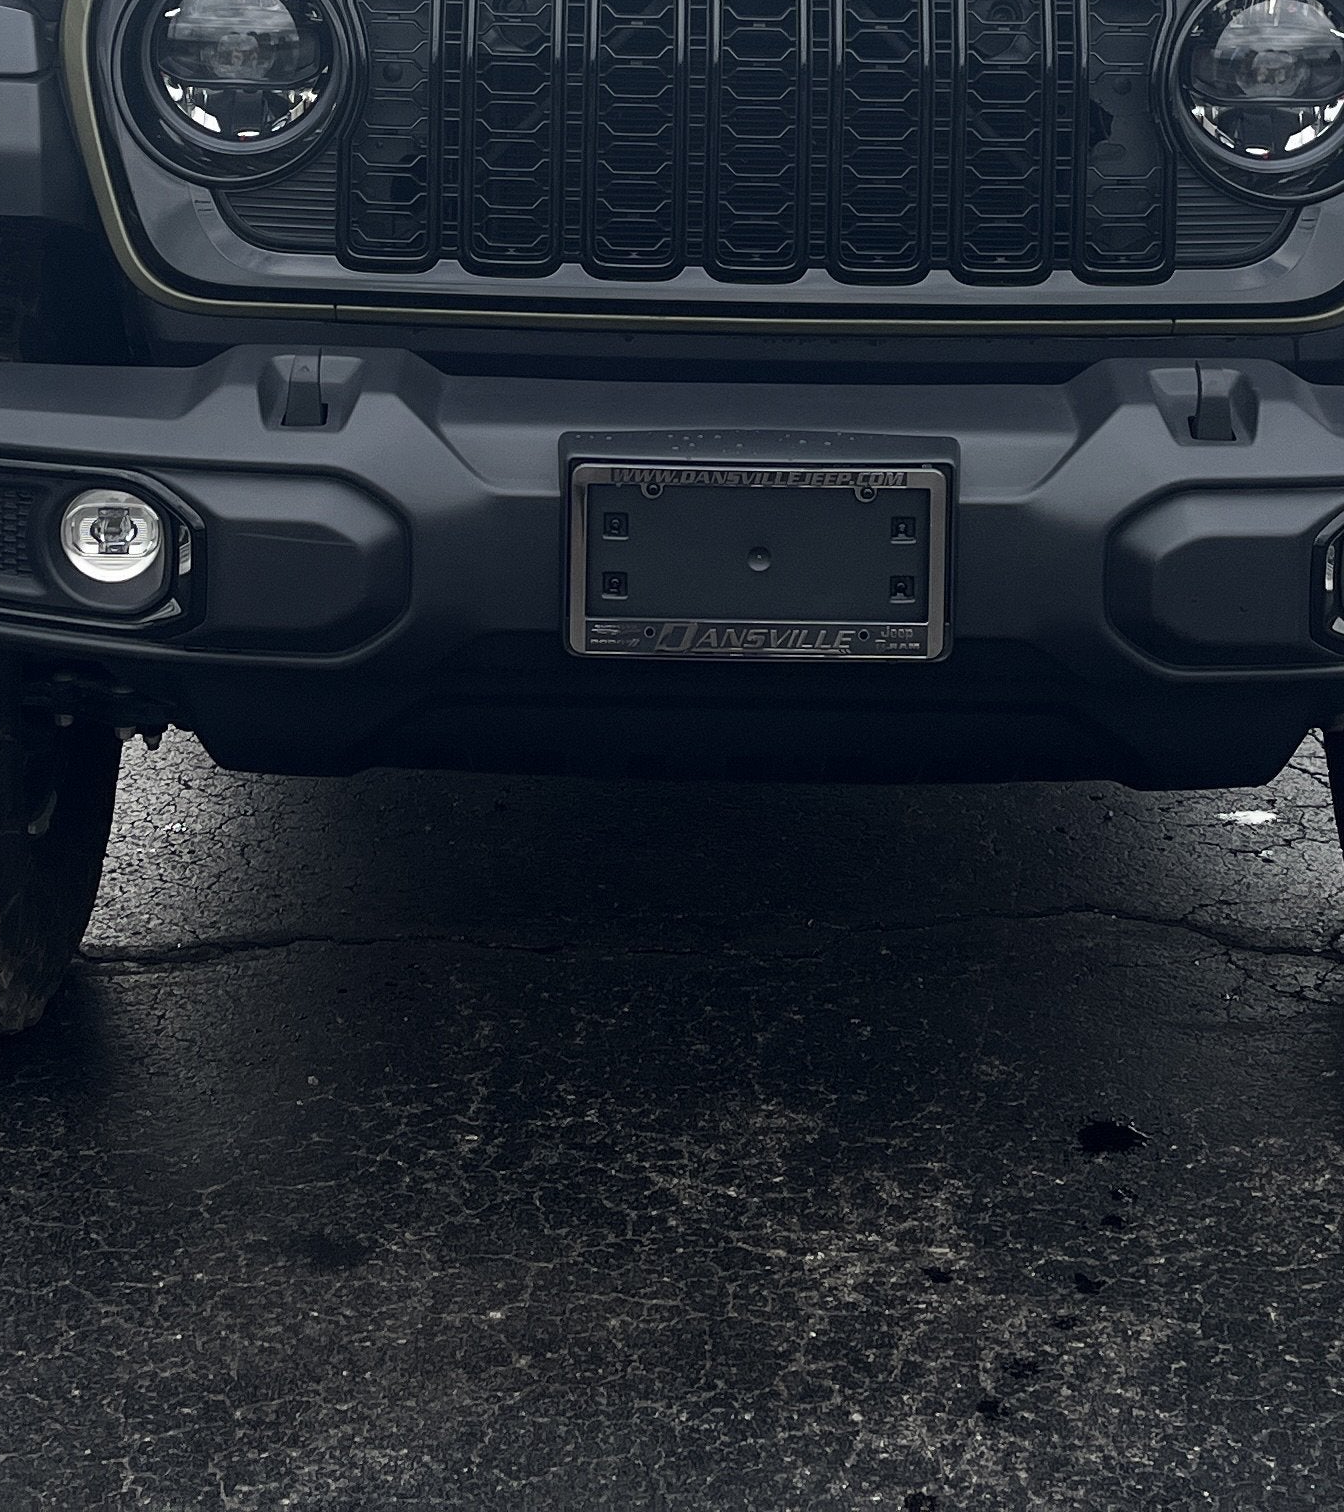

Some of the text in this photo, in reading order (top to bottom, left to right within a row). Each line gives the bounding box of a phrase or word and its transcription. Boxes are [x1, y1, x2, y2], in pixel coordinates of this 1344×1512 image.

[613, 468, 905, 487] WWW.DANSVILLEJEEP.COM
[656, 622, 857, 652] DANSVILLE
[880, 625, 914, 640] Jeep
